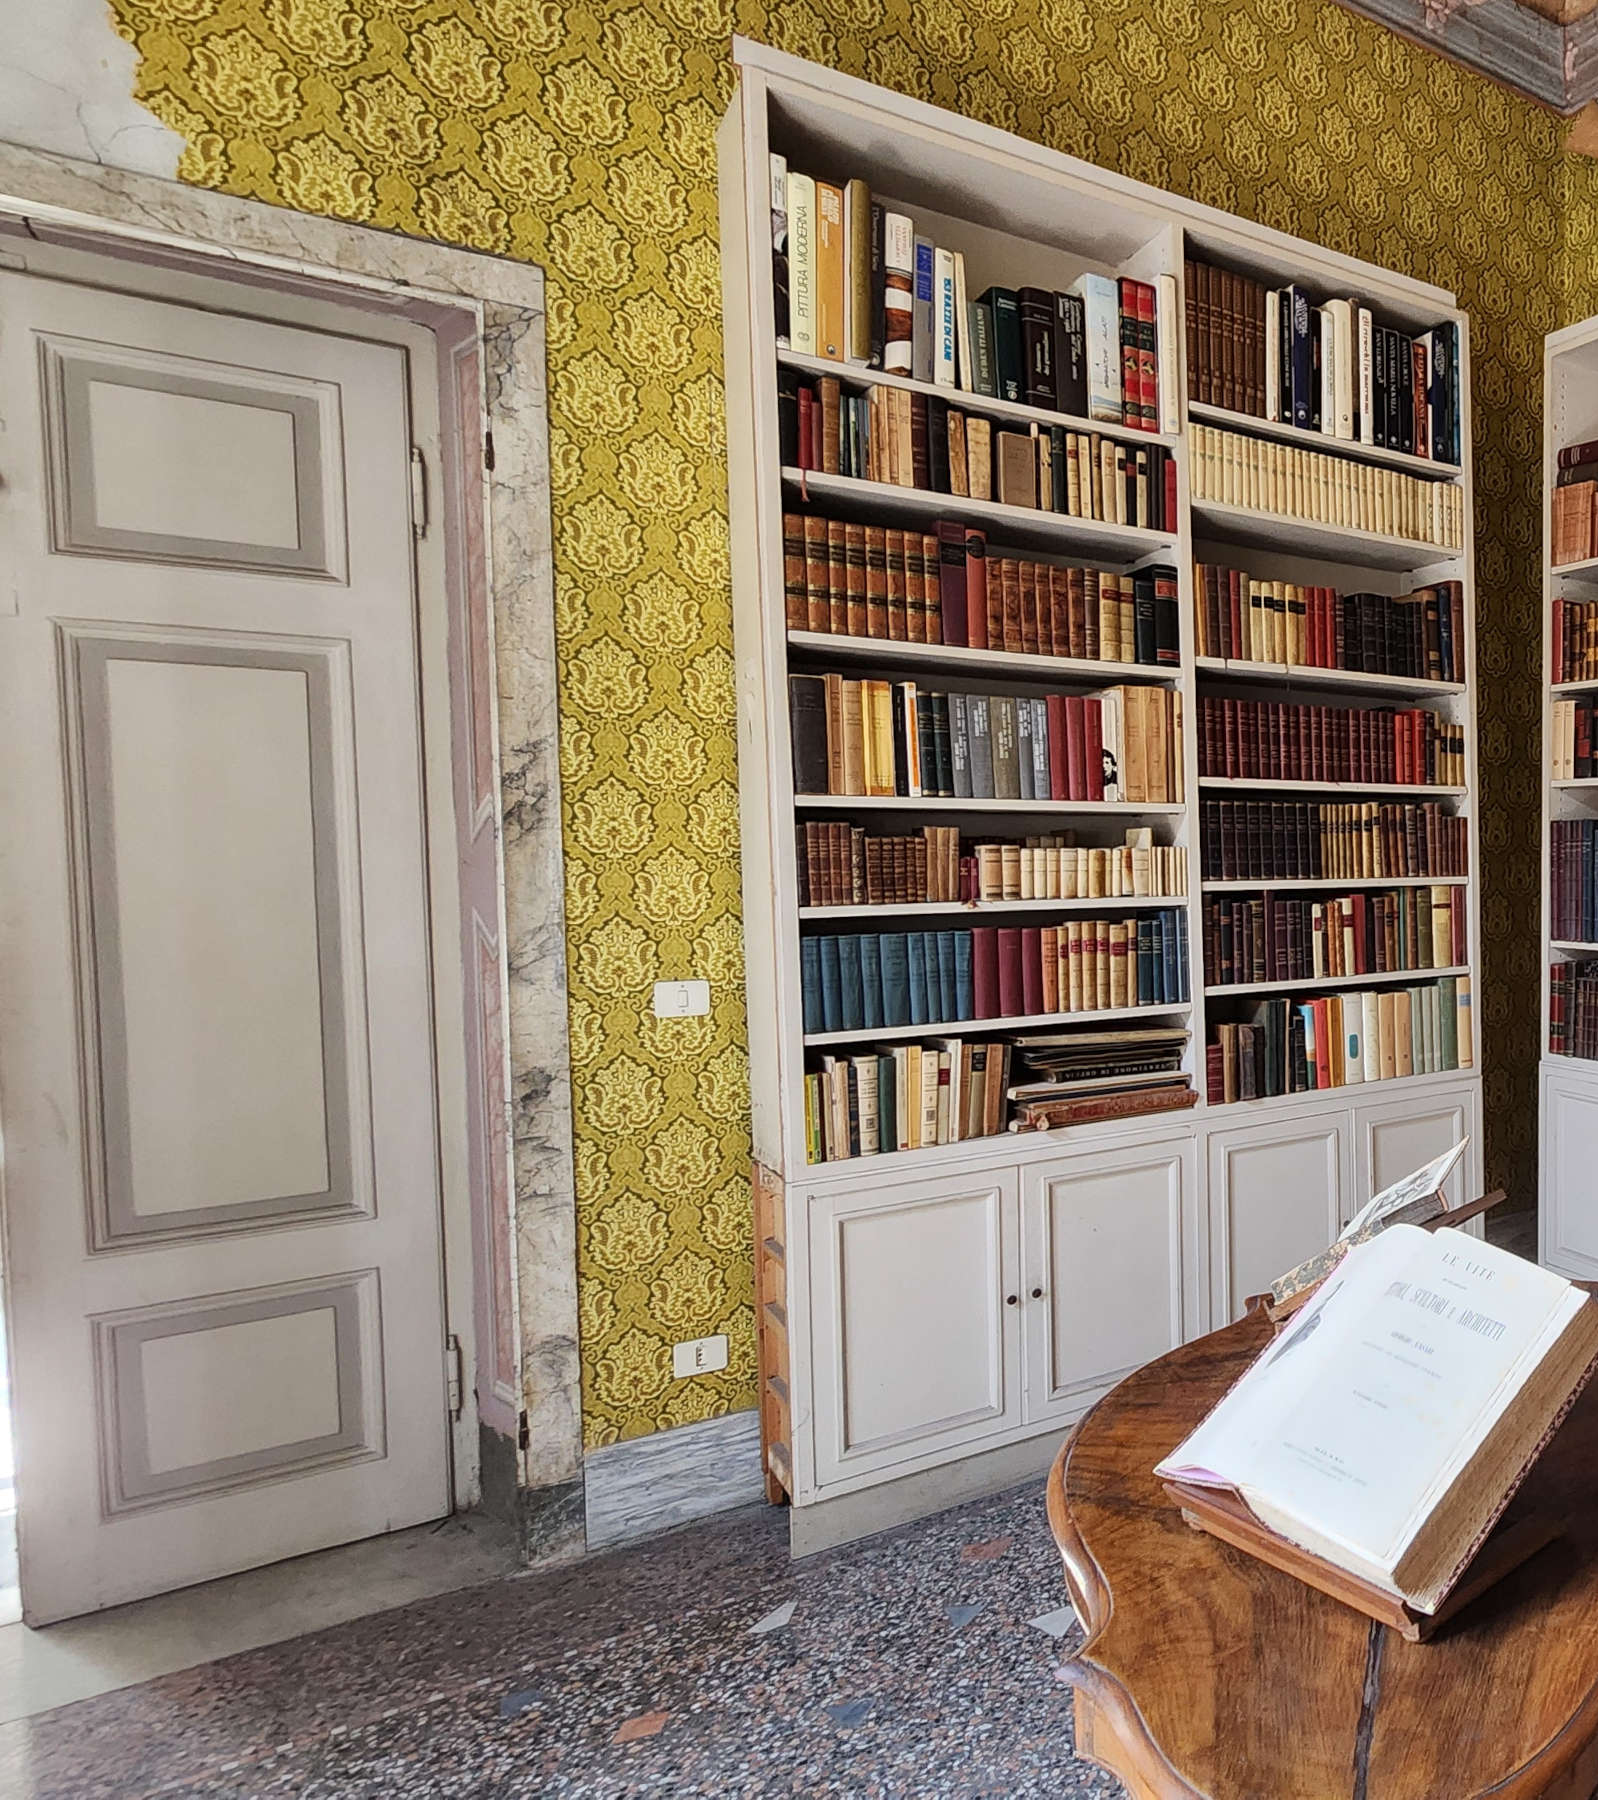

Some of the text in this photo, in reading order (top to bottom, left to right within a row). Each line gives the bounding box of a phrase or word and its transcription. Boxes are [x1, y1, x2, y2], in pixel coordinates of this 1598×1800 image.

[796, 206, 808, 265] MODERNA
[796, 270, 808, 318] PITTURA
[944, 293, 952, 325] RAZZE
[944, 326, 952, 337] DI
[976, 308, 986, 347] ITALIANO
[944, 338, 952, 362] CANI
[1441, 1252, 1496, 1281] LE VITE
[1457, 1309, 1507, 1341] ARCHITETTI
